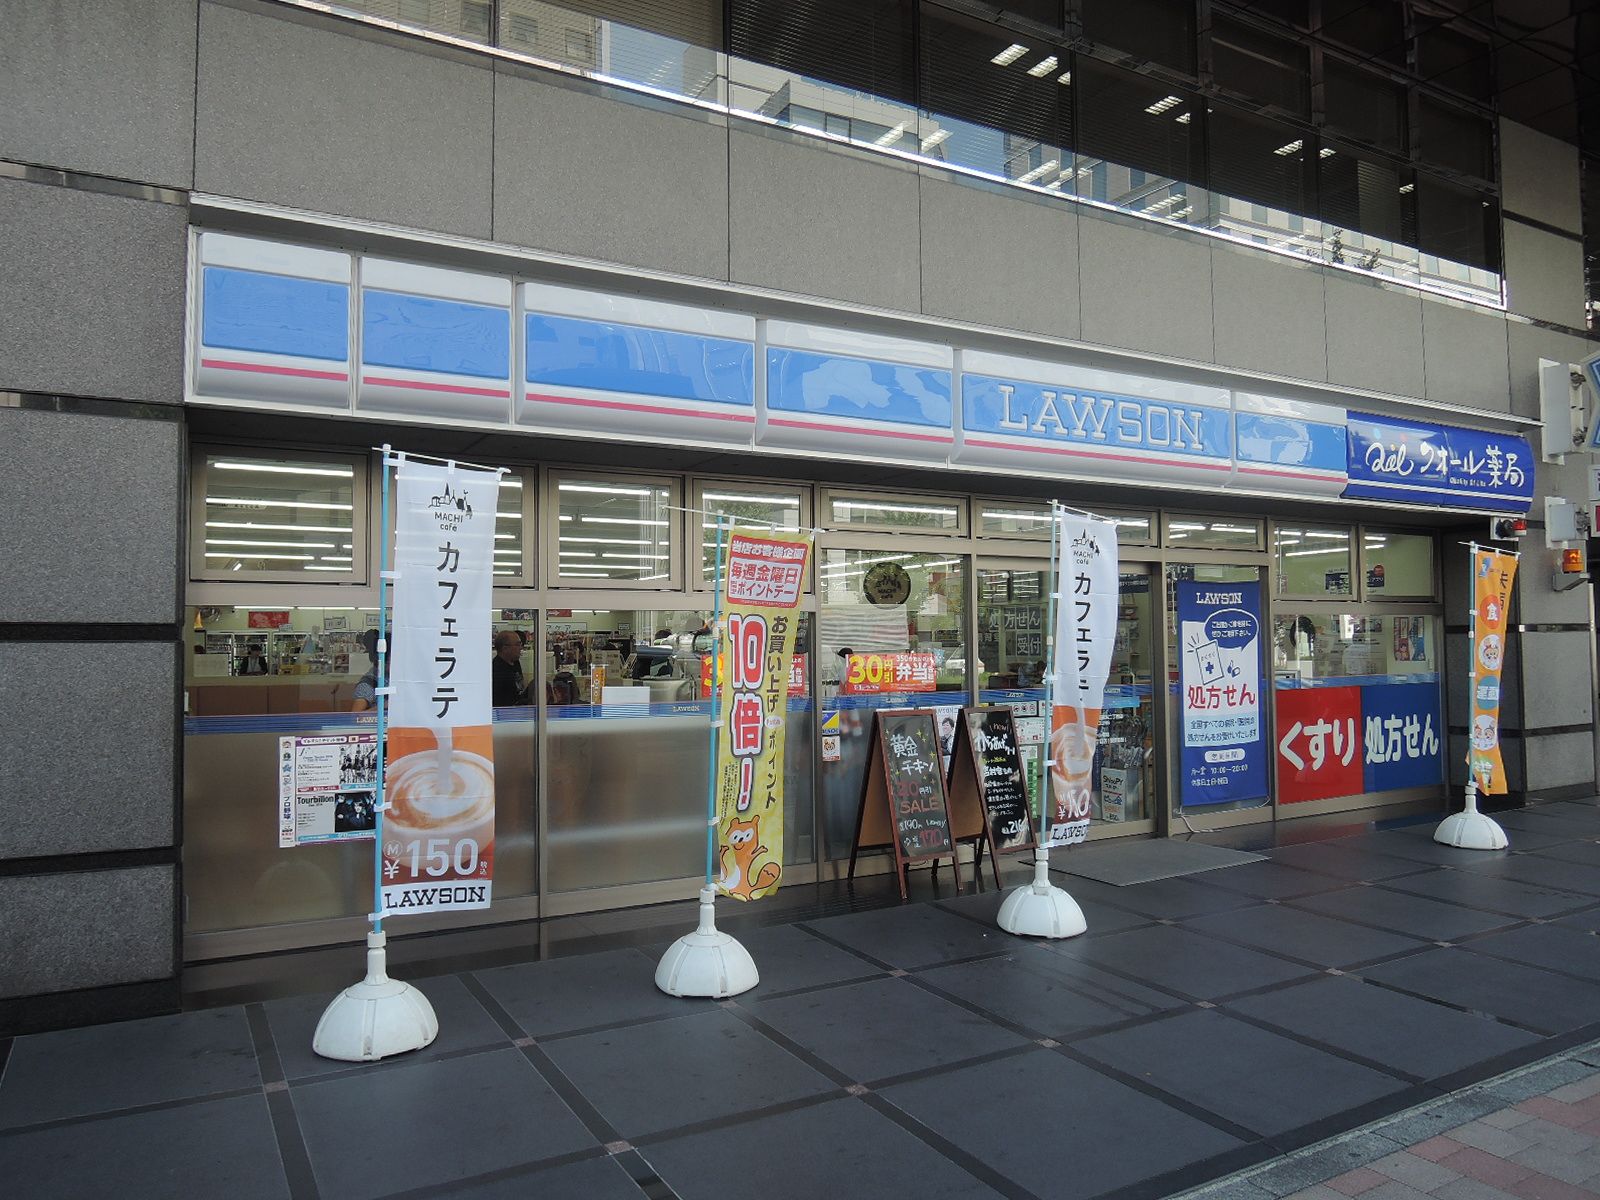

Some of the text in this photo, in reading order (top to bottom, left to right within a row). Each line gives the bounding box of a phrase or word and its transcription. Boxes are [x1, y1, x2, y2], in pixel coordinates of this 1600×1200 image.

[999, 385, 1203, 451] LAWSON
[434, 510, 464, 523] MACHI
[440, 523, 458, 532] café
[732, 540, 805, 560] 当店お客様企画
[1073, 551, 1093, 559] MACHI
[731, 561, 798, 585] 毎週金曜日
[738, 581, 795, 599] ポイントデー
[1196, 592, 1242, 605] LAWSON
[431, 541, 460, 719] カフェラテ
[1017, 637, 1041, 656] 受付
[766, 616, 788, 713] お買い上げ
[896, 662, 928, 681] 弁当
[1188, 684, 1256, 709] 処方せん
[889, 734, 918, 758] 黄金
[1279, 717, 1355, 771] くすり
[1364, 713, 1439, 765] 処方せん
[765, 731, 777, 809] ポイント
[901, 759, 934, 776] チキン
[297, 795, 334, 805] Tourbillon
[900, 798, 940, 814] SALE
[387, 845, 400, 856] M
[384, 886, 486, 909] LAWSON
